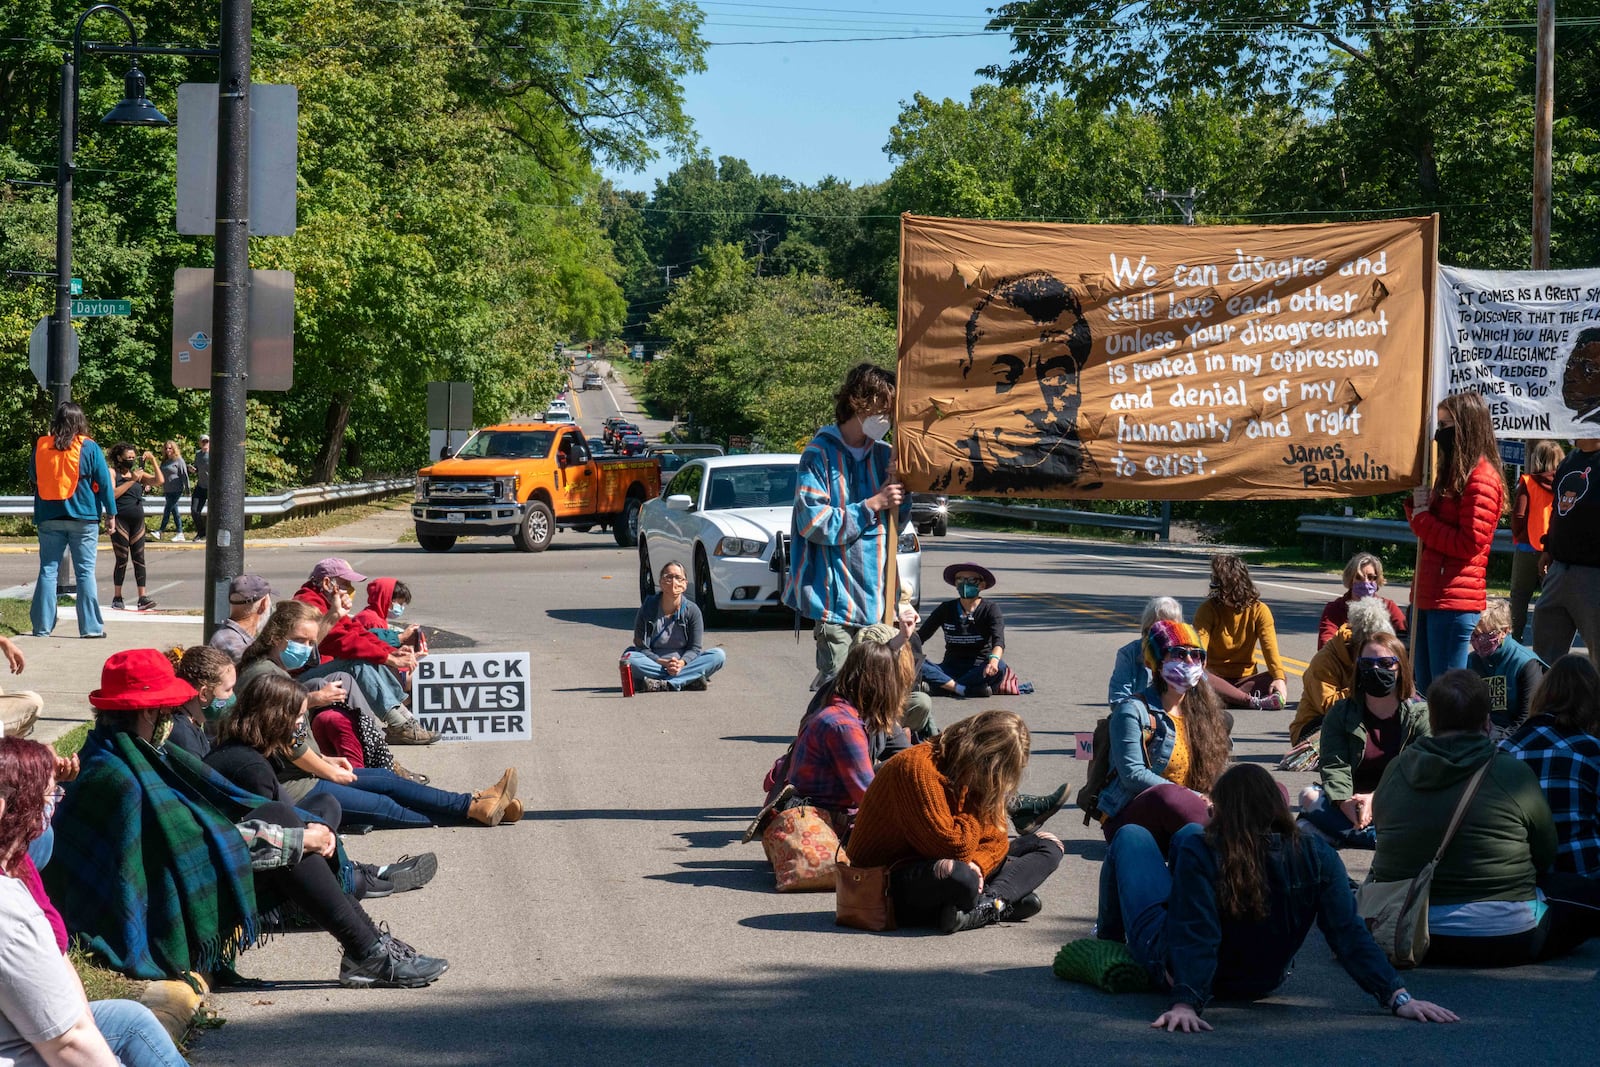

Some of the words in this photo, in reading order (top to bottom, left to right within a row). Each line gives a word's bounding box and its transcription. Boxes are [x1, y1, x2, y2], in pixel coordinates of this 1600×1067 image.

[1109, 252, 1159, 287] We
[1173, 264, 1218, 287] can
[1228, 248, 1327, 287] disagree
[1339, 251, 1387, 276] and
[1168, 292, 1214, 320] love
[1226, 290, 1281, 316] each
[1289, 285, 1358, 313] other
[1518, 288, 1531, 302] AS
[1534, 287, 1542, 302] A
[1545, 285, 1581, 302] GREAT
[77, 302, 116, 315] Dayton
[1528, 312, 1555, 324] THAT
[1560, 311, 1579, 324] THE
[1239, 310, 1389, 346] disagreement
[1471, 328, 1509, 342] WHICH
[1538, 329, 1569, 342] HAVE
[1106, 360, 1128, 384] is
[1133, 353, 1198, 382] rooted
[1203, 350, 1225, 372] in
[1231, 354, 1262, 376] my
[1271, 349, 1379, 373] oppression
[1450, 345, 1492, 365] PLEDGED
[1450, 368, 1472, 383] HAS
[1475, 365, 1496, 379] NOT
[1499, 365, 1547, 378] PLEDGED
[1110, 385, 1154, 411] and
[1169, 379, 1247, 407] denial
[1263, 379, 1291, 407] of
[1300, 380, 1336, 402] my
[1117, 412, 1232, 444] humanity
[1245, 412, 1291, 439] and
[1305, 405, 1362, 435] right
[1493, 412, 1551, 431] BALDWIN
[1110, 449, 1137, 477] to
[1145, 450, 1217, 476] exist.
[1282, 443, 1345, 466] James
[1300, 452, 1389, 487] Baldwin
[418, 660, 523, 680] BLACK
[423, 685, 520, 710] LIVES
[419, 715, 524, 734] MATTER
